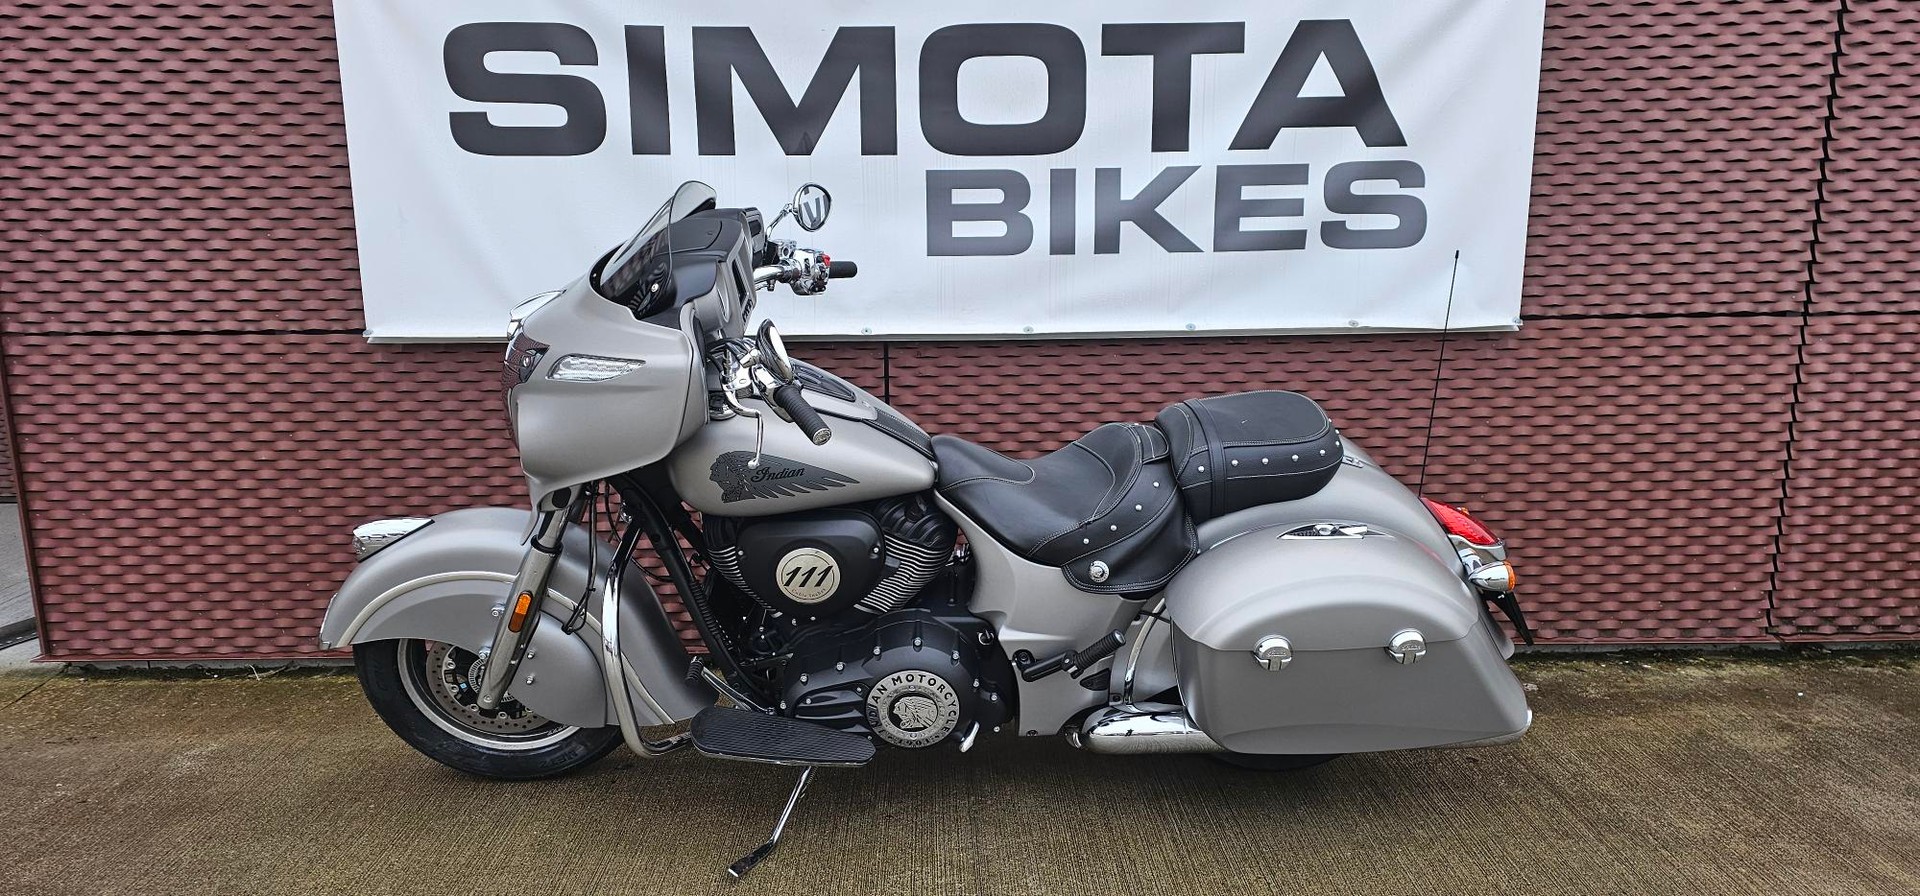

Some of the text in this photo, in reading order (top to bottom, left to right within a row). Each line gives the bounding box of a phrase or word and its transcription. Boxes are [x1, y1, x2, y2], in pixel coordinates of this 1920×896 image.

[443, 19, 1407, 156] SIMOTA
[926, 160, 1427, 256] BIKES
[751, 467, 805, 482] Indian
[783, 565, 833, 587] 111
[868, 673, 957, 735] INDIAN MOTORCYCLE
